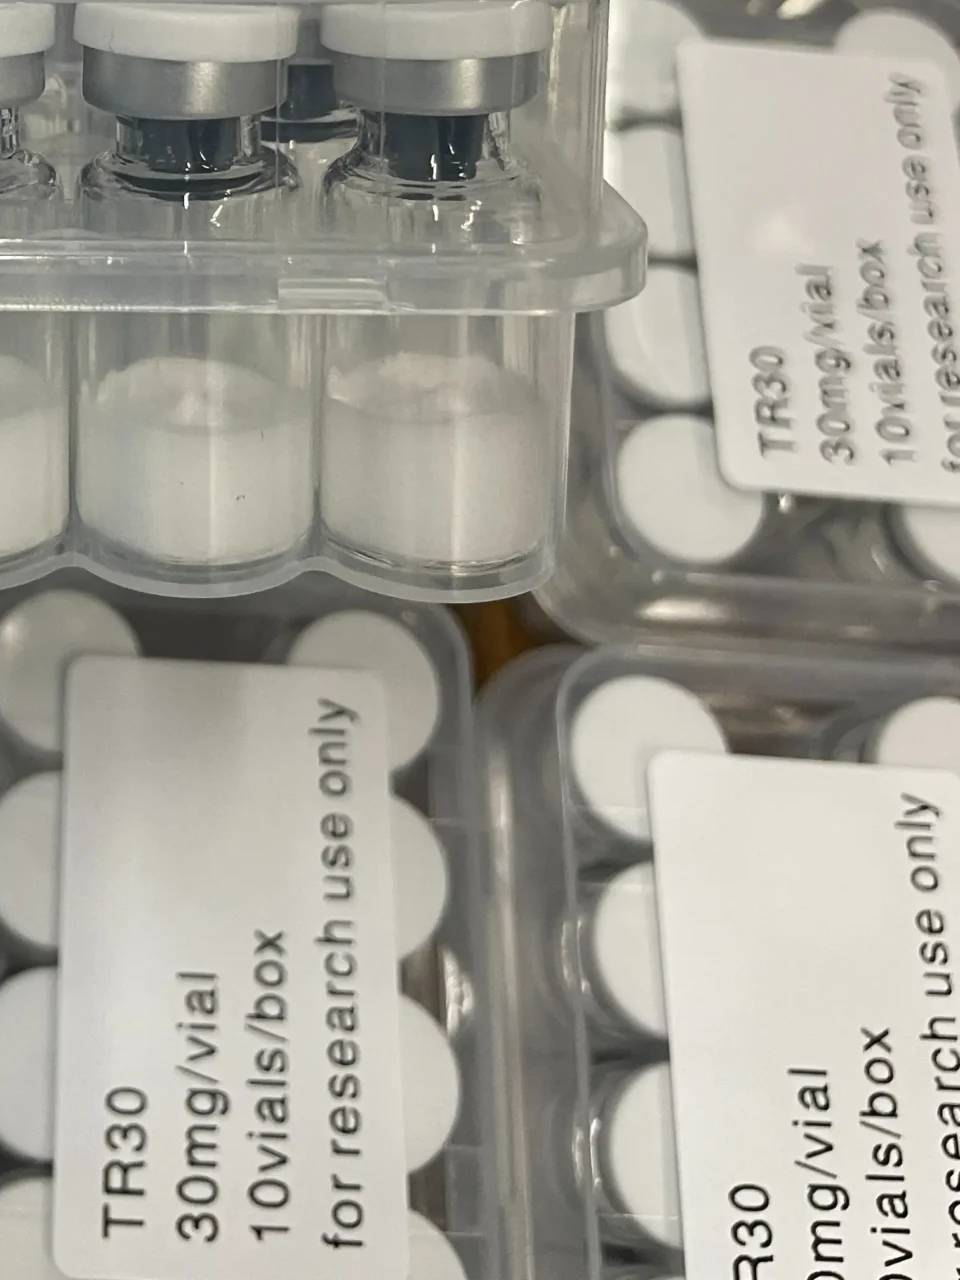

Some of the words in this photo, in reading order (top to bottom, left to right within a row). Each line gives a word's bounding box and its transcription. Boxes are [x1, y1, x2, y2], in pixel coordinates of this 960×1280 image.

[887, 78, 925, 149] only
[902, 157, 935, 224] use
[797, 265, 856, 462] 30mg/vial
[857, 242, 912, 464] 10vials/box
[910, 235, 960, 406] research
[749, 347, 793, 456] TR30
[309, 698, 359, 797] only
[321, 813, 353, 901] use
[895, 794, 941, 893] only
[916, 910, 953, 997] use
[246, 931, 290, 1241] 10vials/box
[315, 920, 361, 1157] research
[102, 1088, 147, 1238] TR30
[176, 973, 230, 1243] 30mg/vial
[860, 1029, 913, 1280] vials/box
[322, 1180, 363, 1249] for
[729, 1184, 774, 1280] R30
[788, 1069, 850, 1280] mg/vial
